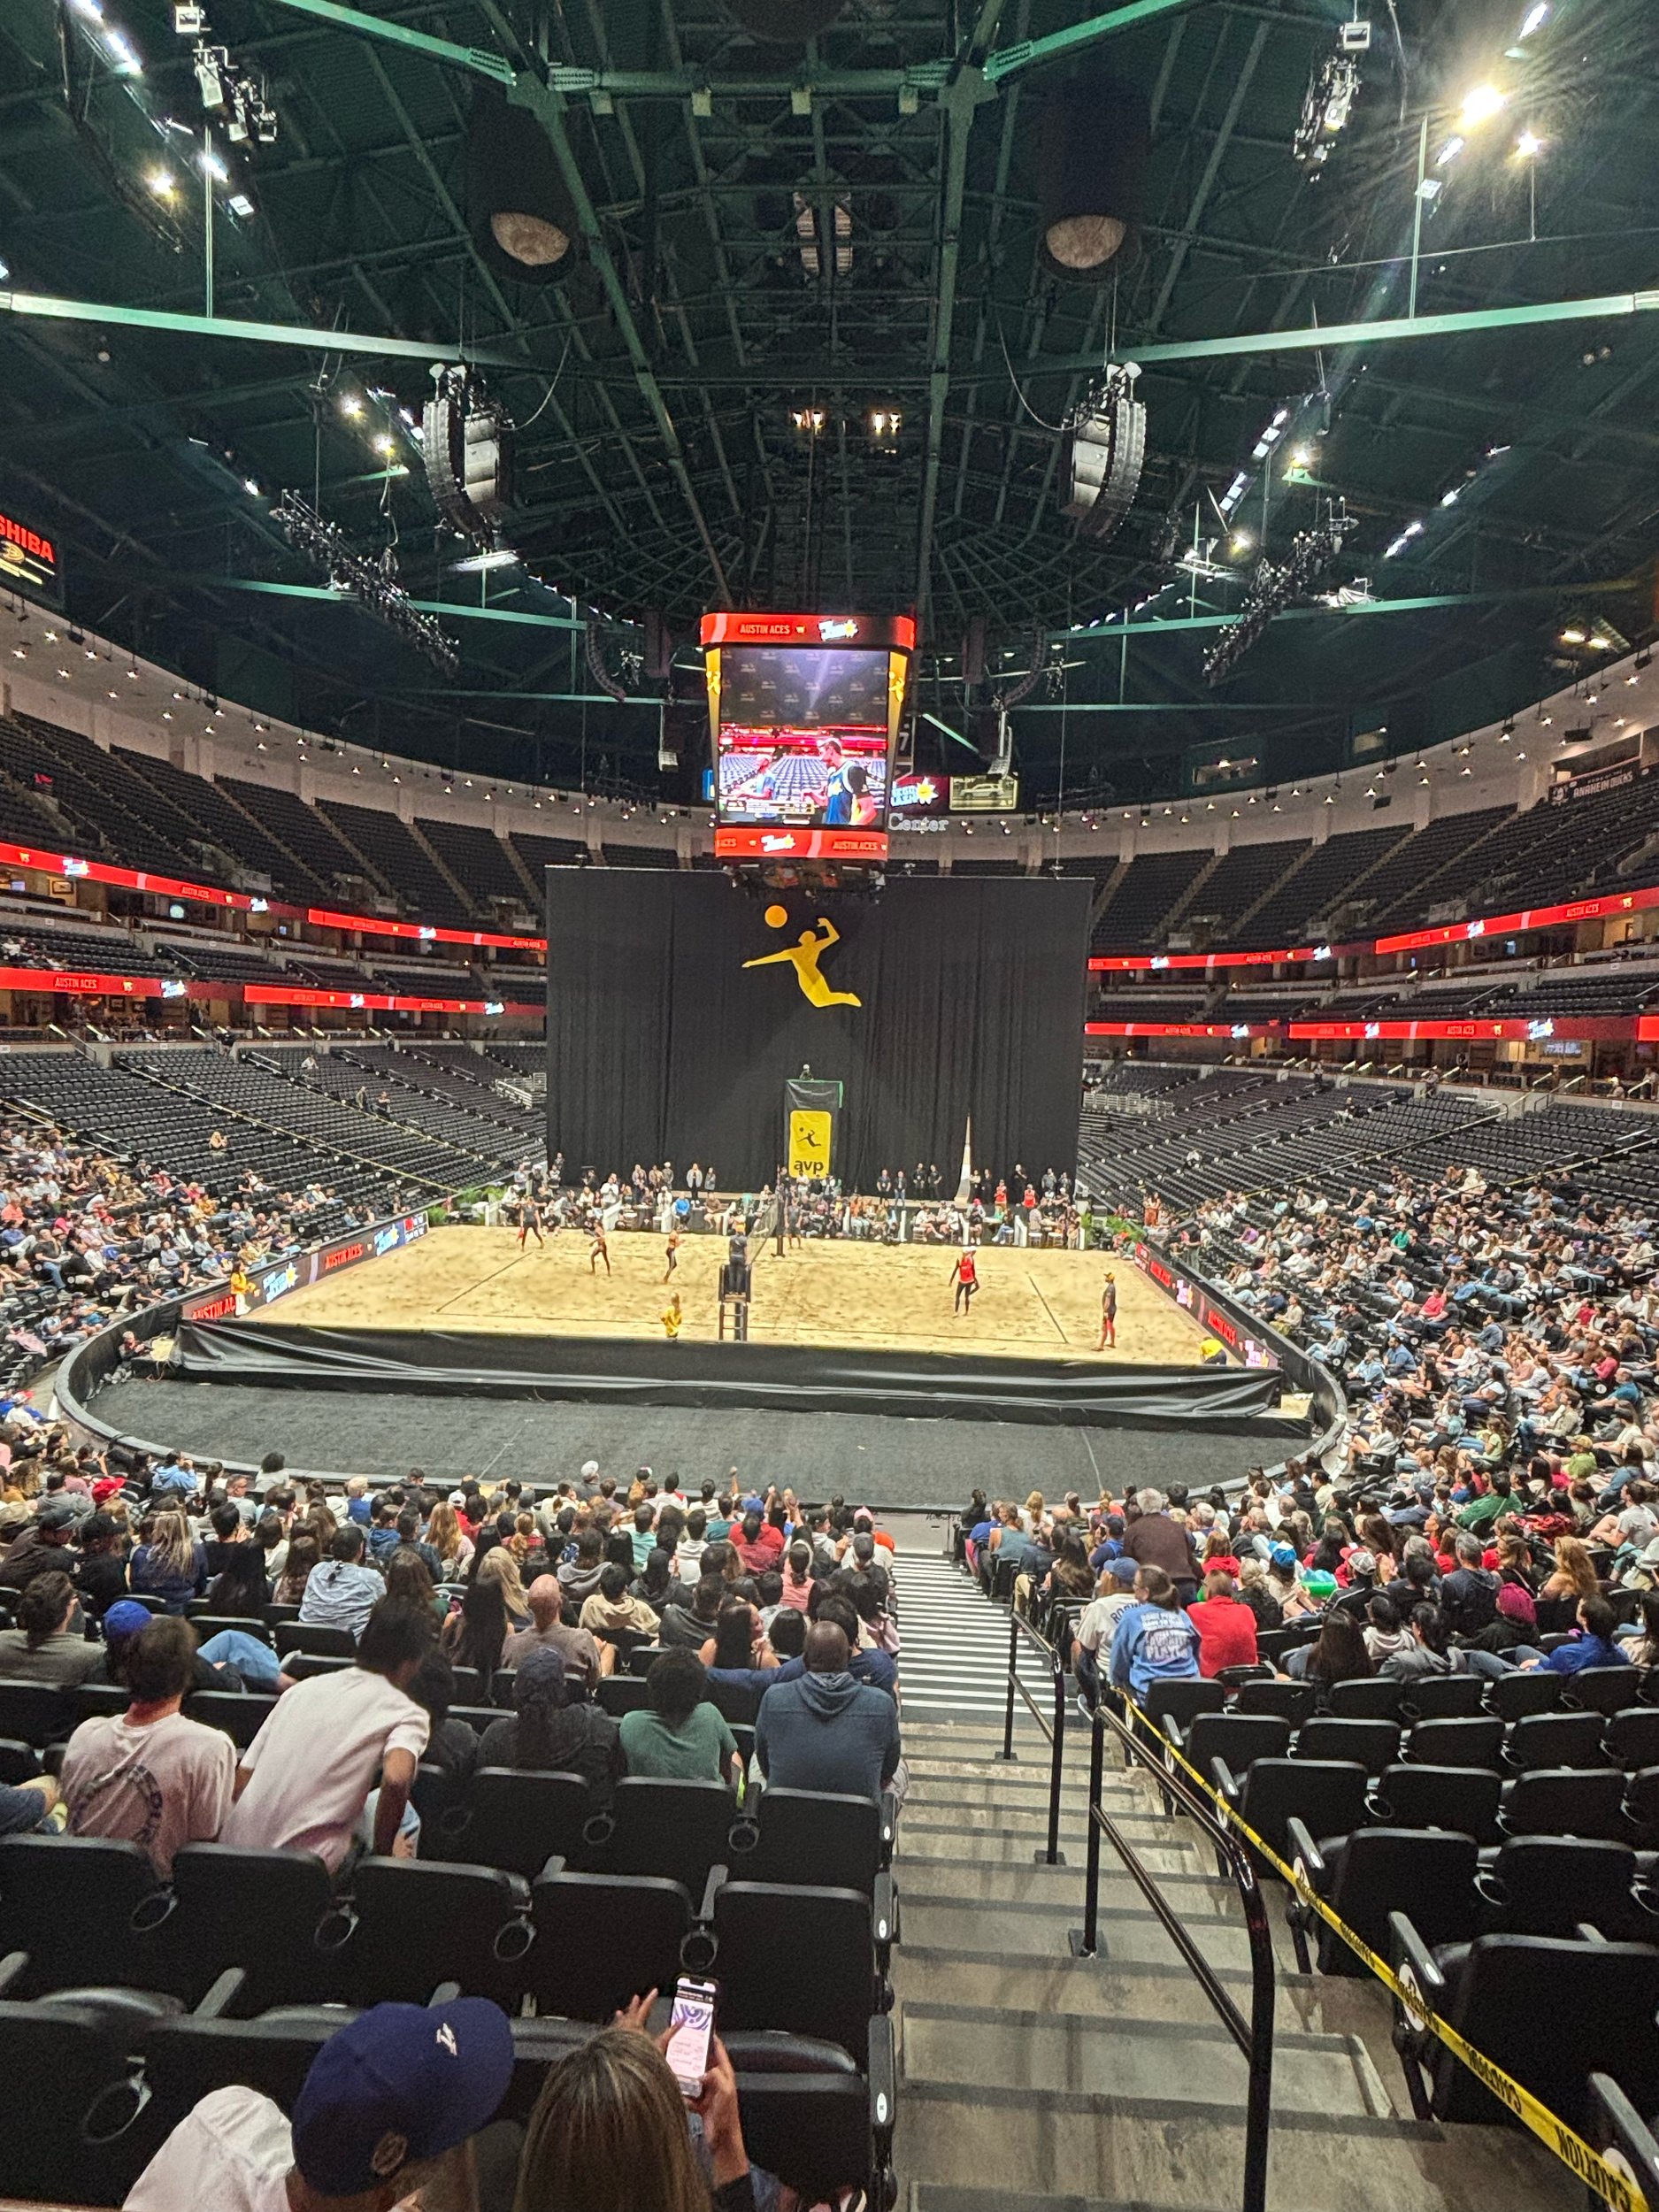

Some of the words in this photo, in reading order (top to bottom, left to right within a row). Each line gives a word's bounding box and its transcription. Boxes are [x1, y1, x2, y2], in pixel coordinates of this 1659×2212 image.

[739, 624, 768, 634] AUSTIN
[769, 625, 790, 634] ACES
[1573, 780, 1609, 798] ANAHEIM
[1609, 771, 1633, 788] DUCKS
[887, 813, 949, 831] Center
[833, 840, 859, 849] AUSTIN
[859, 841, 878, 850] ACES
[55, 978, 79, 987] AUSTIN
[81, 979, 97, 989] ACES
[123, 981, 133, 991] VS
[794, 1160, 824, 1174] avp
[325, 1247, 347, 1268] AUSTIN
[347, 1243, 363, 1260] ACES
[192, 1298, 223, 1319] AUSTIN
[1462, 2040, 1523, 2116] CAUTION
[1554, 2124, 1631, 2210] CAUTION
